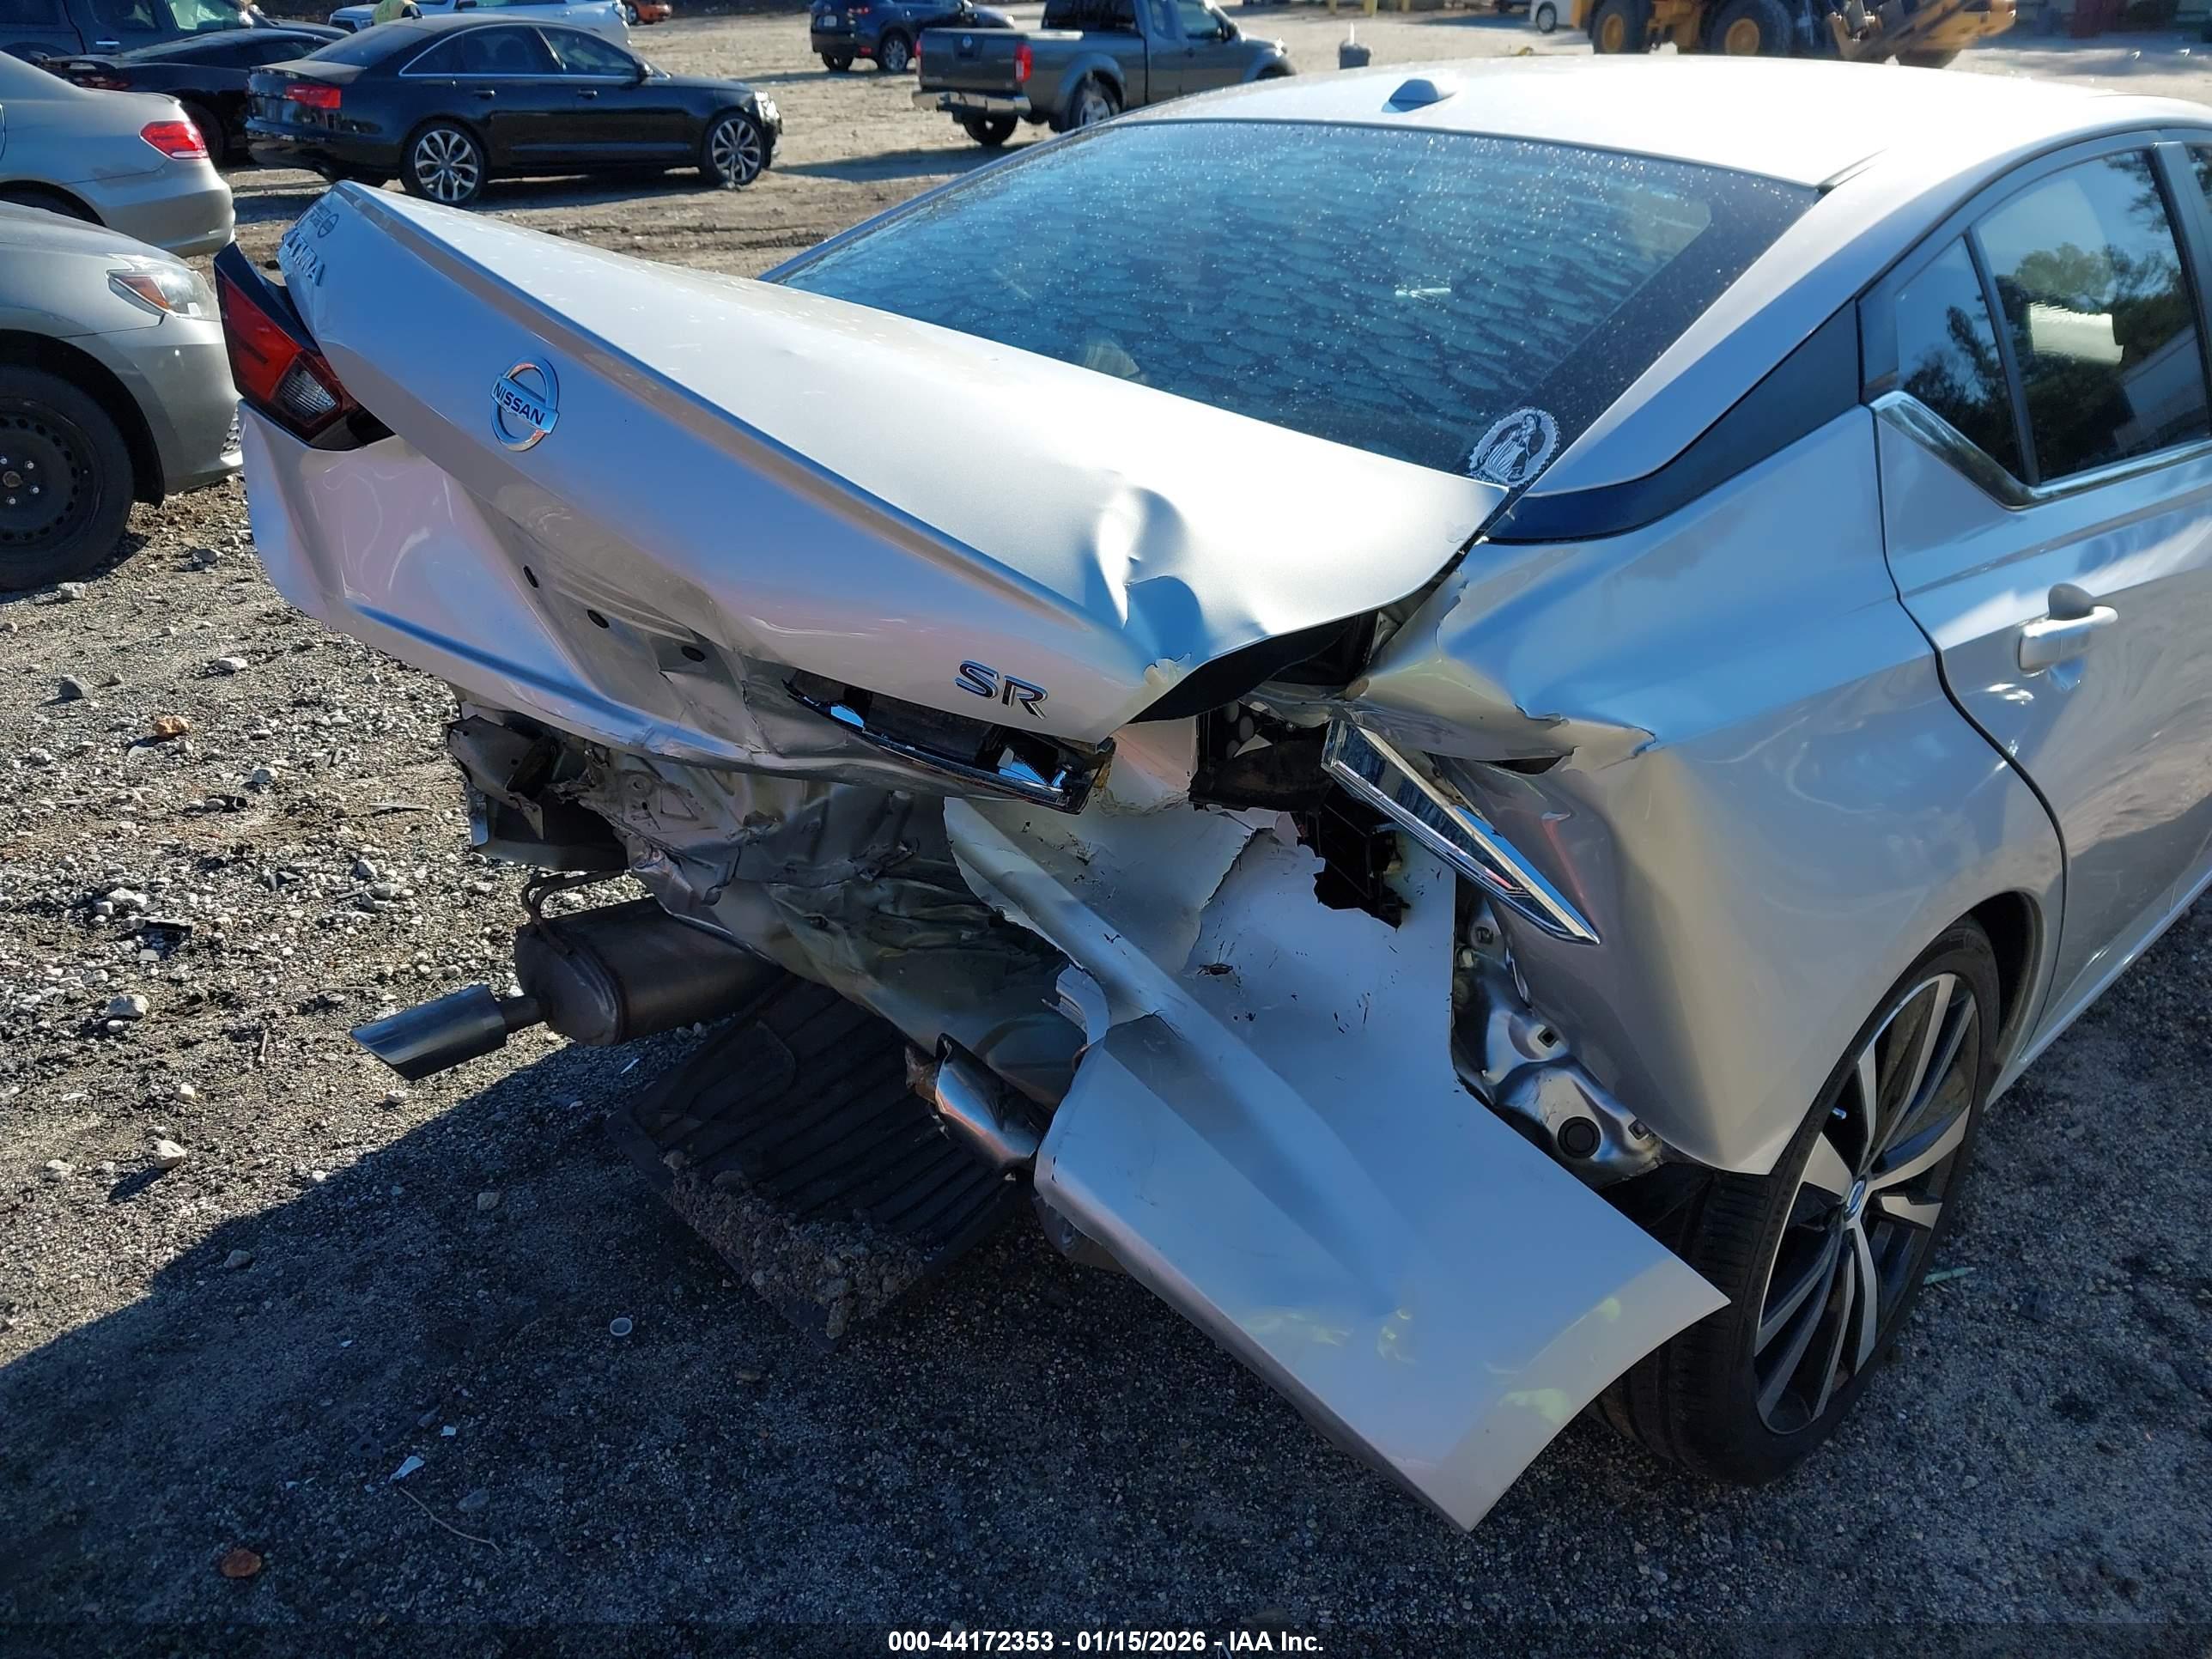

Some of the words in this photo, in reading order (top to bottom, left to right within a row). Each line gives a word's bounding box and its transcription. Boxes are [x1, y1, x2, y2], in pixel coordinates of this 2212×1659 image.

[283, 227, 325, 287] LTIMA
[493, 382, 546, 426] NISSAN
[954, 659, 1048, 721] SR
